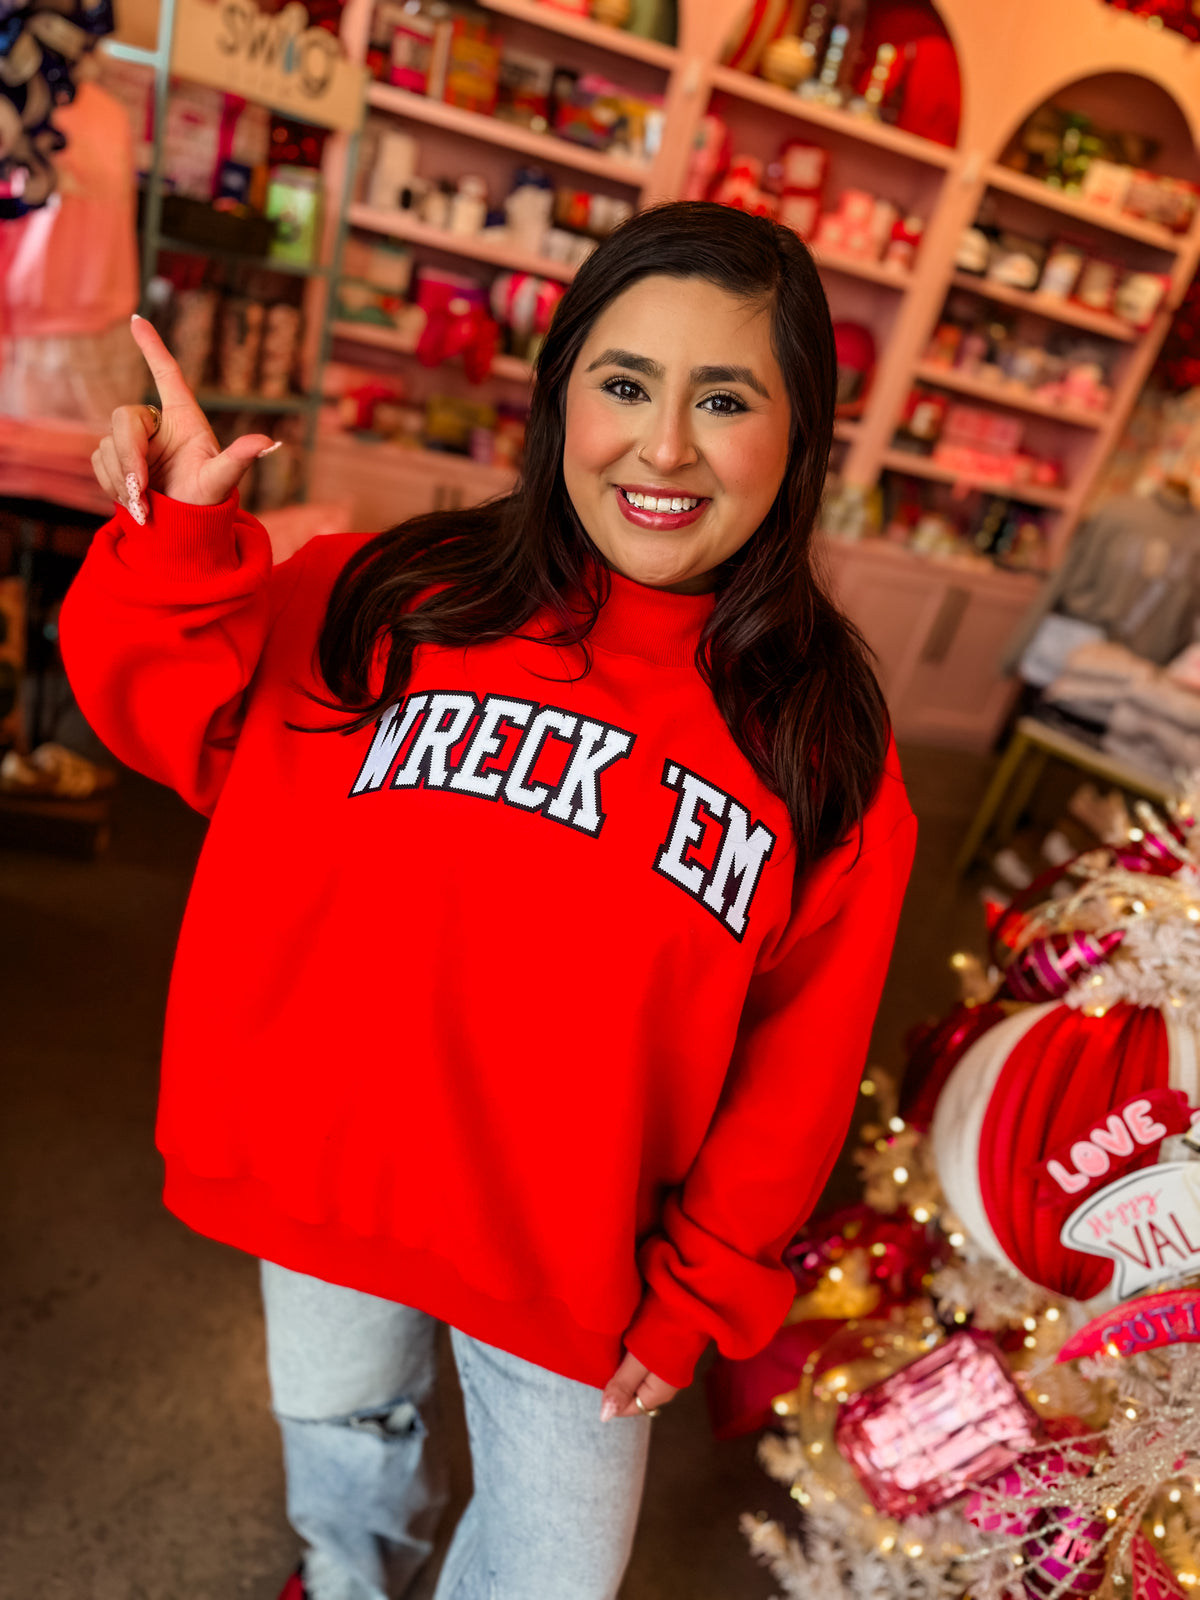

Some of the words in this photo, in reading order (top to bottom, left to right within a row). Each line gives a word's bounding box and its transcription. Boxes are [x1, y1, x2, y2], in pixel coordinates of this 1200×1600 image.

[348, 689, 637, 839] WRECK
[652, 758, 777, 943] 'EM
[1046, 1098, 1167, 1194] LOVE
[1086, 1188, 1163, 1240] Happy
